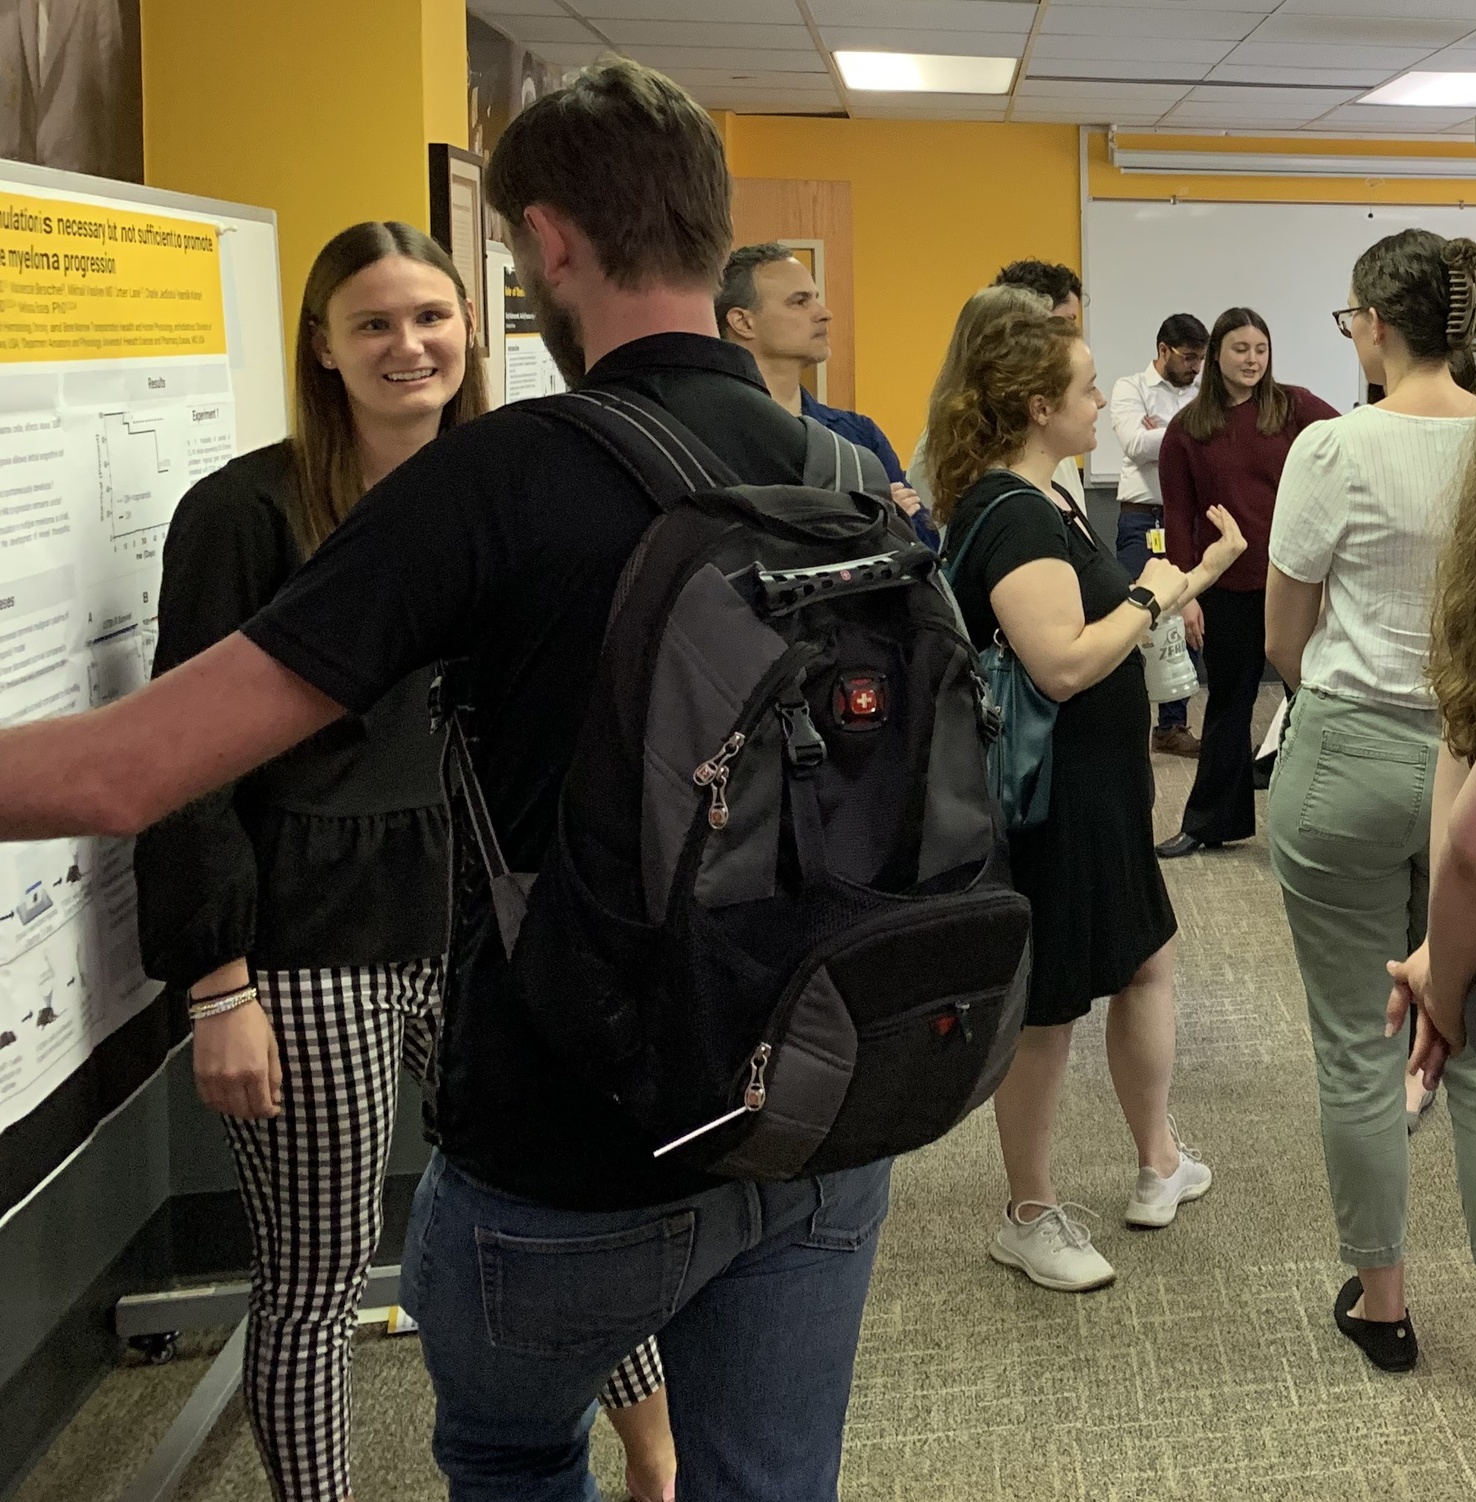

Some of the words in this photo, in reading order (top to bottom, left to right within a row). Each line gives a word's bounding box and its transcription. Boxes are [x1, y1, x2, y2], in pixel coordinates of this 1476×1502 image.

[57, 215, 106, 246] necessary
[121, 225, 136, 243] not
[138, 223, 173, 249] sufficient
[184, 233, 213, 254] promote
[8, 244, 60, 275] myeloma
[63, 251, 116, 278] progression
